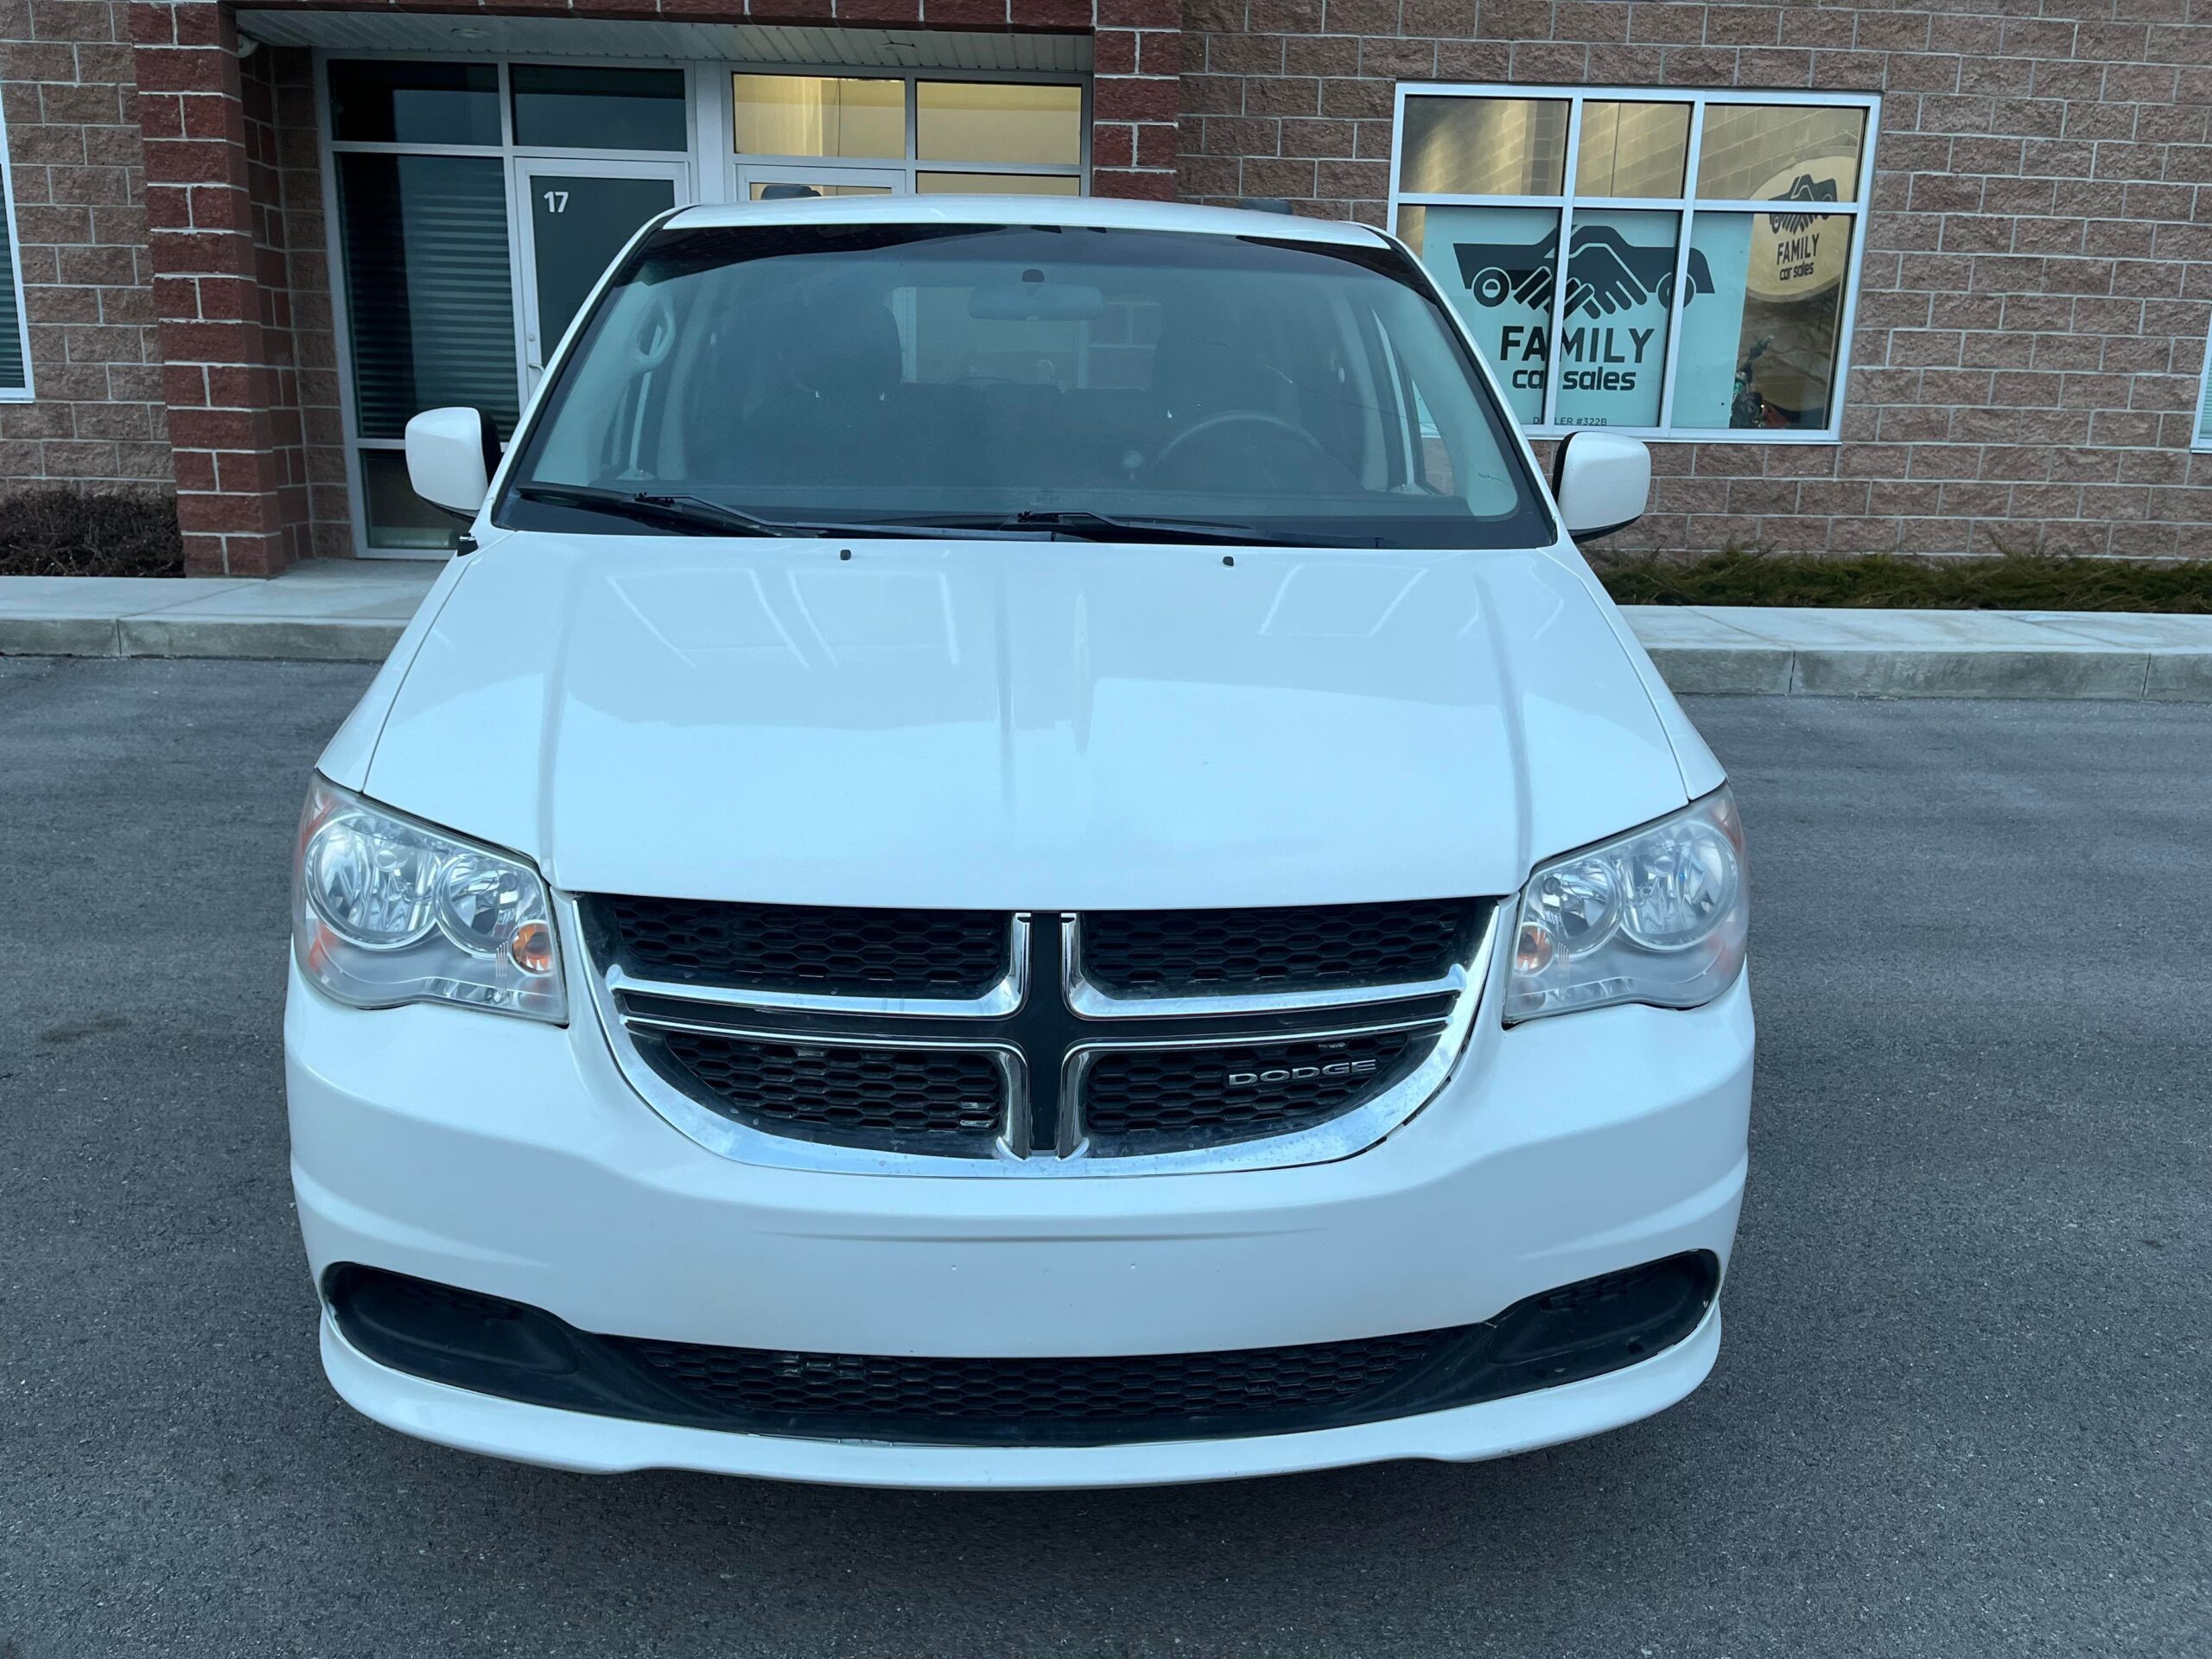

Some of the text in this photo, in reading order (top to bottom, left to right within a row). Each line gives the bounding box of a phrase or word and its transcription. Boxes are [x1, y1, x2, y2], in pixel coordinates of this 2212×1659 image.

[543, 191, 569, 213] 17
[1777, 232, 1820, 265] FAMILY
[1780, 261, 1815, 281] car sales
[1500, 326, 1655, 364] FAMILY
[1512, 366, 1637, 391] ca sales
[1533, 416, 1607, 426] DLER #322B
[1229, 1059, 1376, 1085] DODGE
